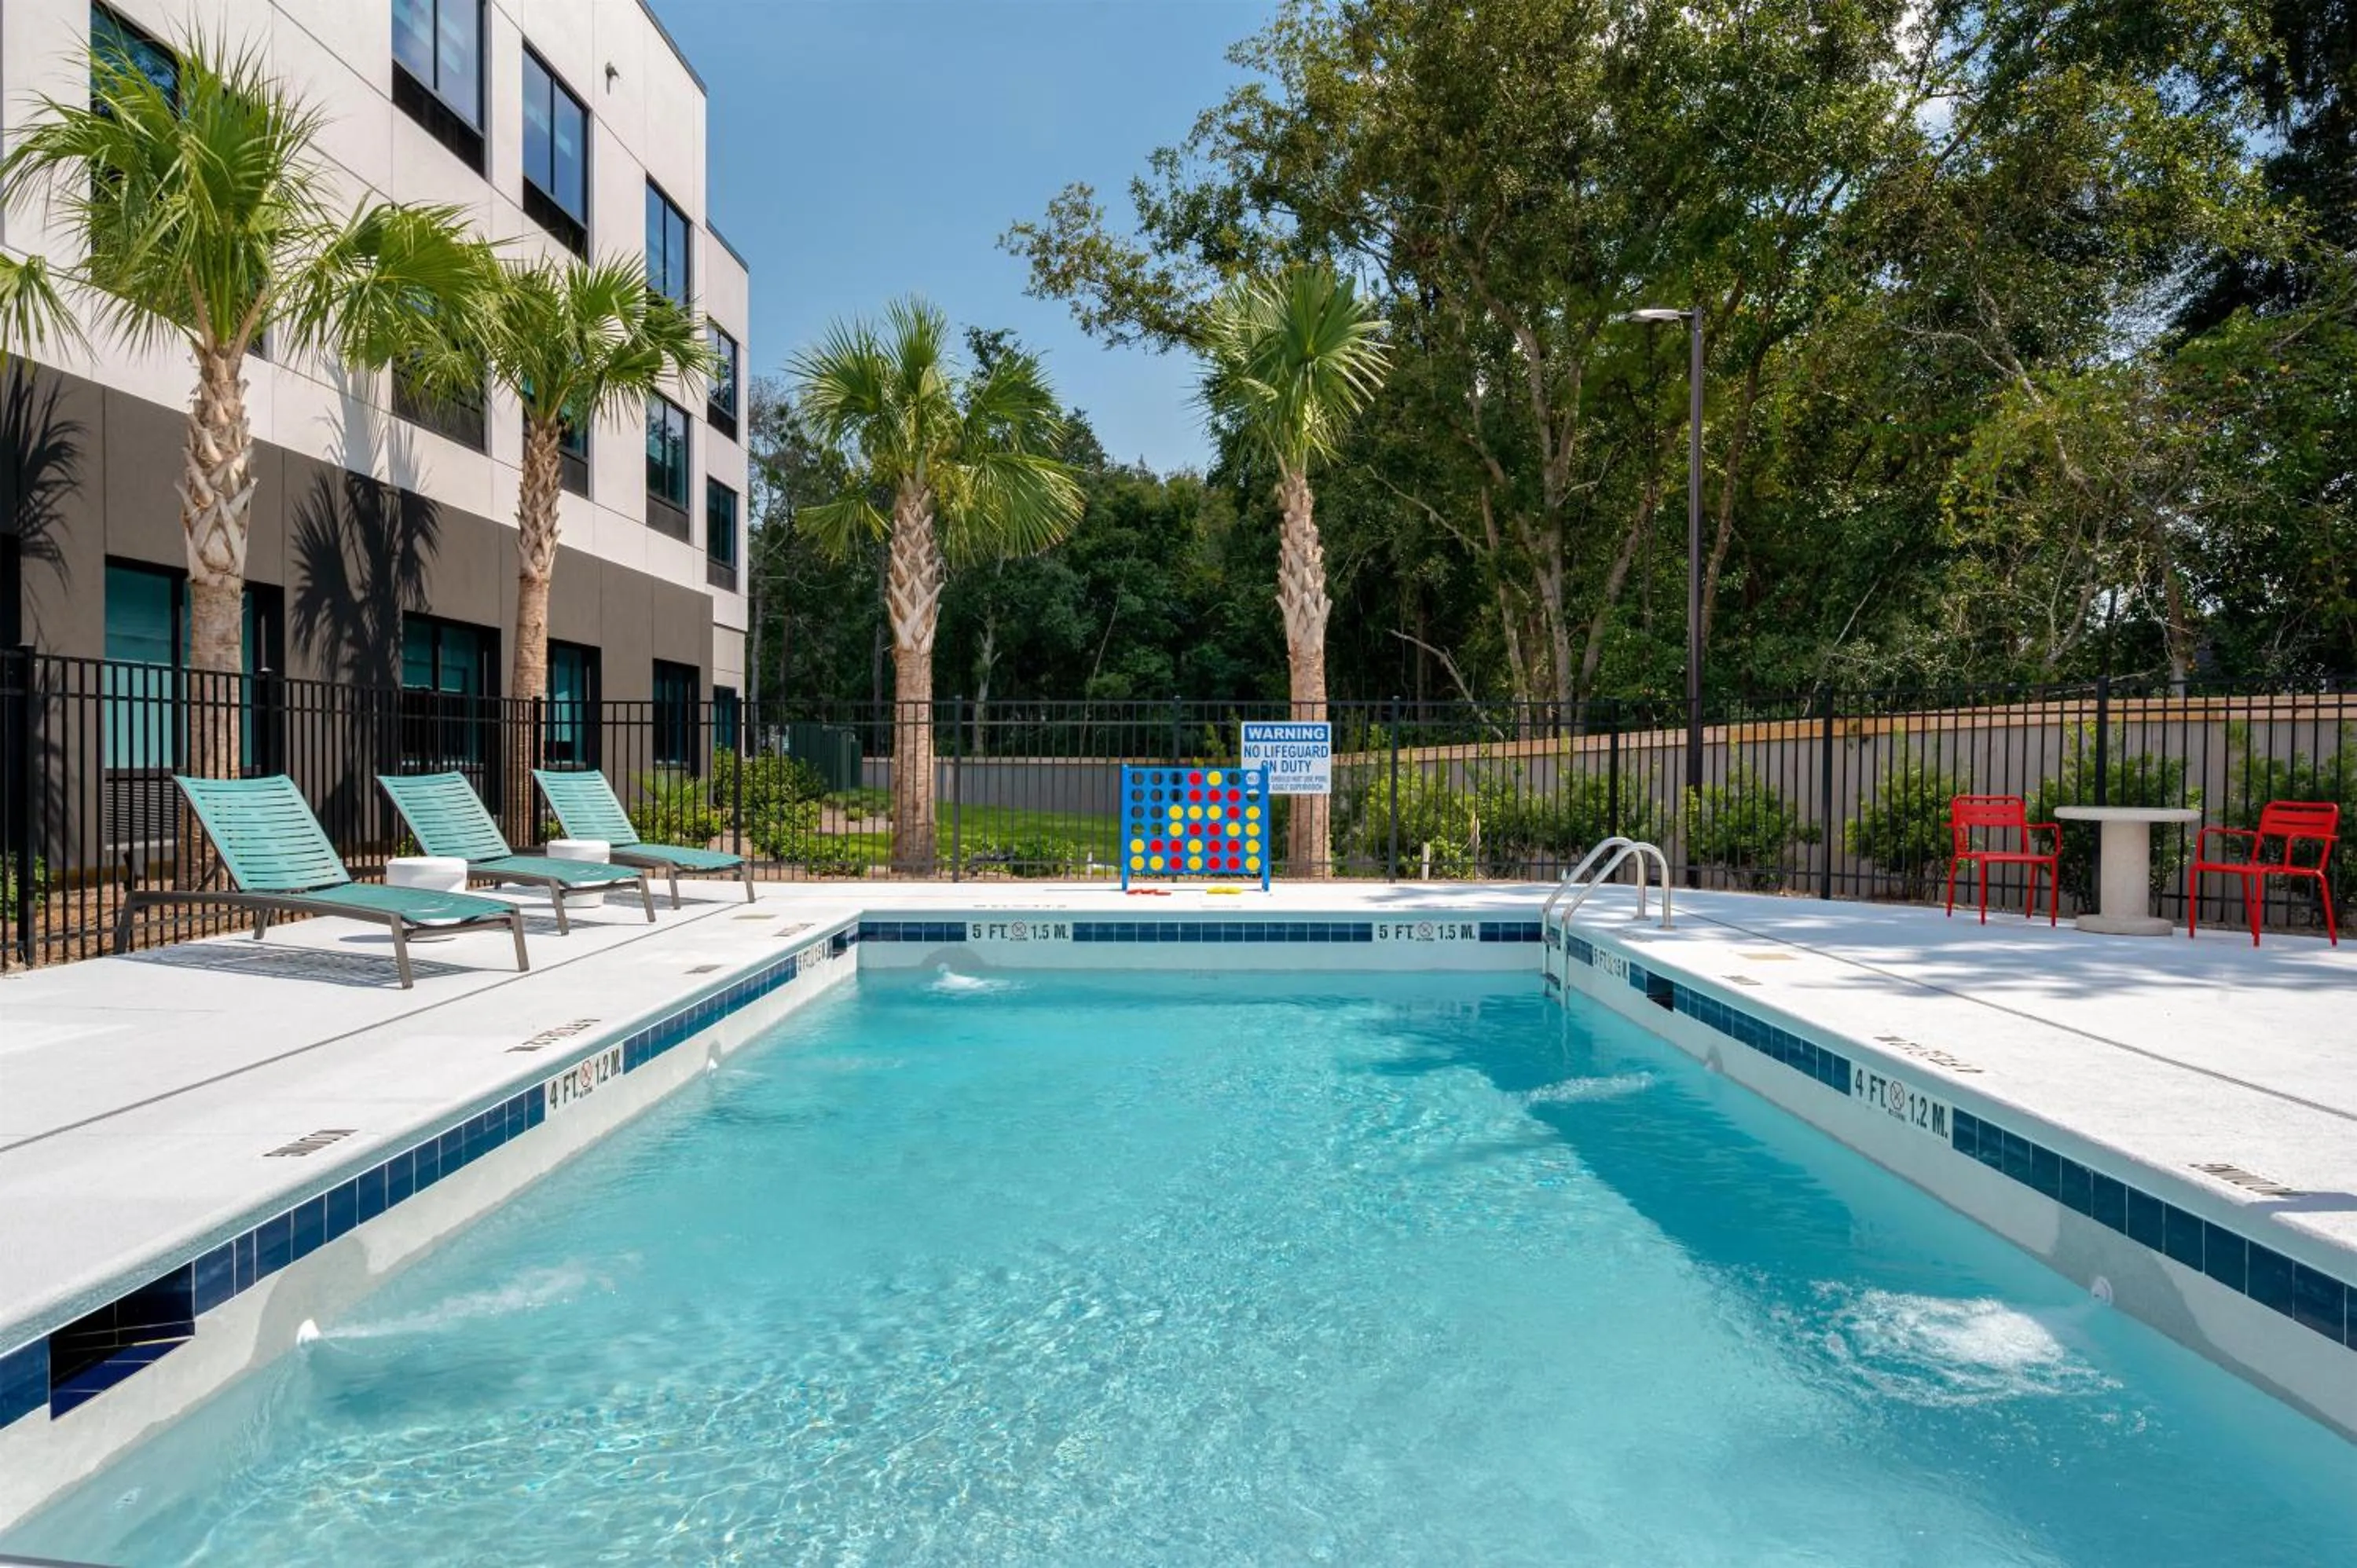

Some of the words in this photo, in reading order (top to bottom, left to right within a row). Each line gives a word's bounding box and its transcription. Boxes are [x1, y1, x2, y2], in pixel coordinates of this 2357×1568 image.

[1248, 727, 1325, 739] WARNING
[1244, 745, 1261, 757] NO
[1264, 745, 1329, 757] LIFEGUARD
[1281, 760, 1311, 773] DUTY
[973, 925, 981, 939] 5
[1031, 925, 1049, 939] 1.5
[1379, 925, 1388, 940] 5
[1438, 925, 1456, 940] 1.5
[550, 1080, 558, 1110] 4
[595, 1058, 609, 1086] 1.2
[1855, 1068, 1864, 1097] 4
[1909, 1093, 1927, 1129] 1.2
